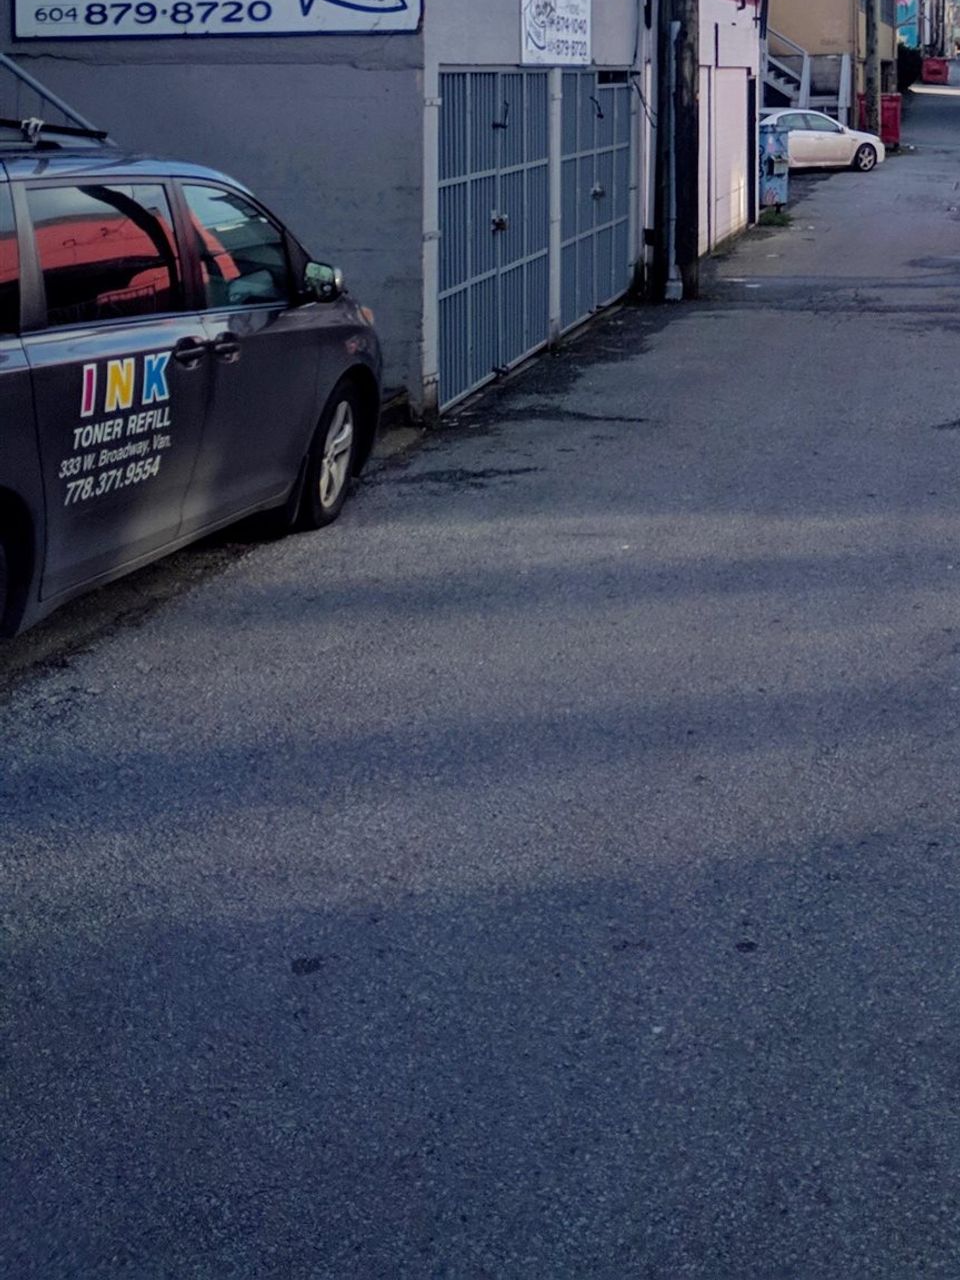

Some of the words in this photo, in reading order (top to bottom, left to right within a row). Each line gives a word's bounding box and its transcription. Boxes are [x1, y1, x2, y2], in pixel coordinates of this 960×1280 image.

[35, 6, 77, 23] 604
[80, 351, 172, 418] INK
[73, 418, 123, 450] TONER
[126, 407, 171, 435] REFILL
[59, 455, 82, 479] 333
[83, 452, 95, 472] W.
[153, 434, 172, 450] Van.
[64, 455, 162, 507] 778.371.9554
